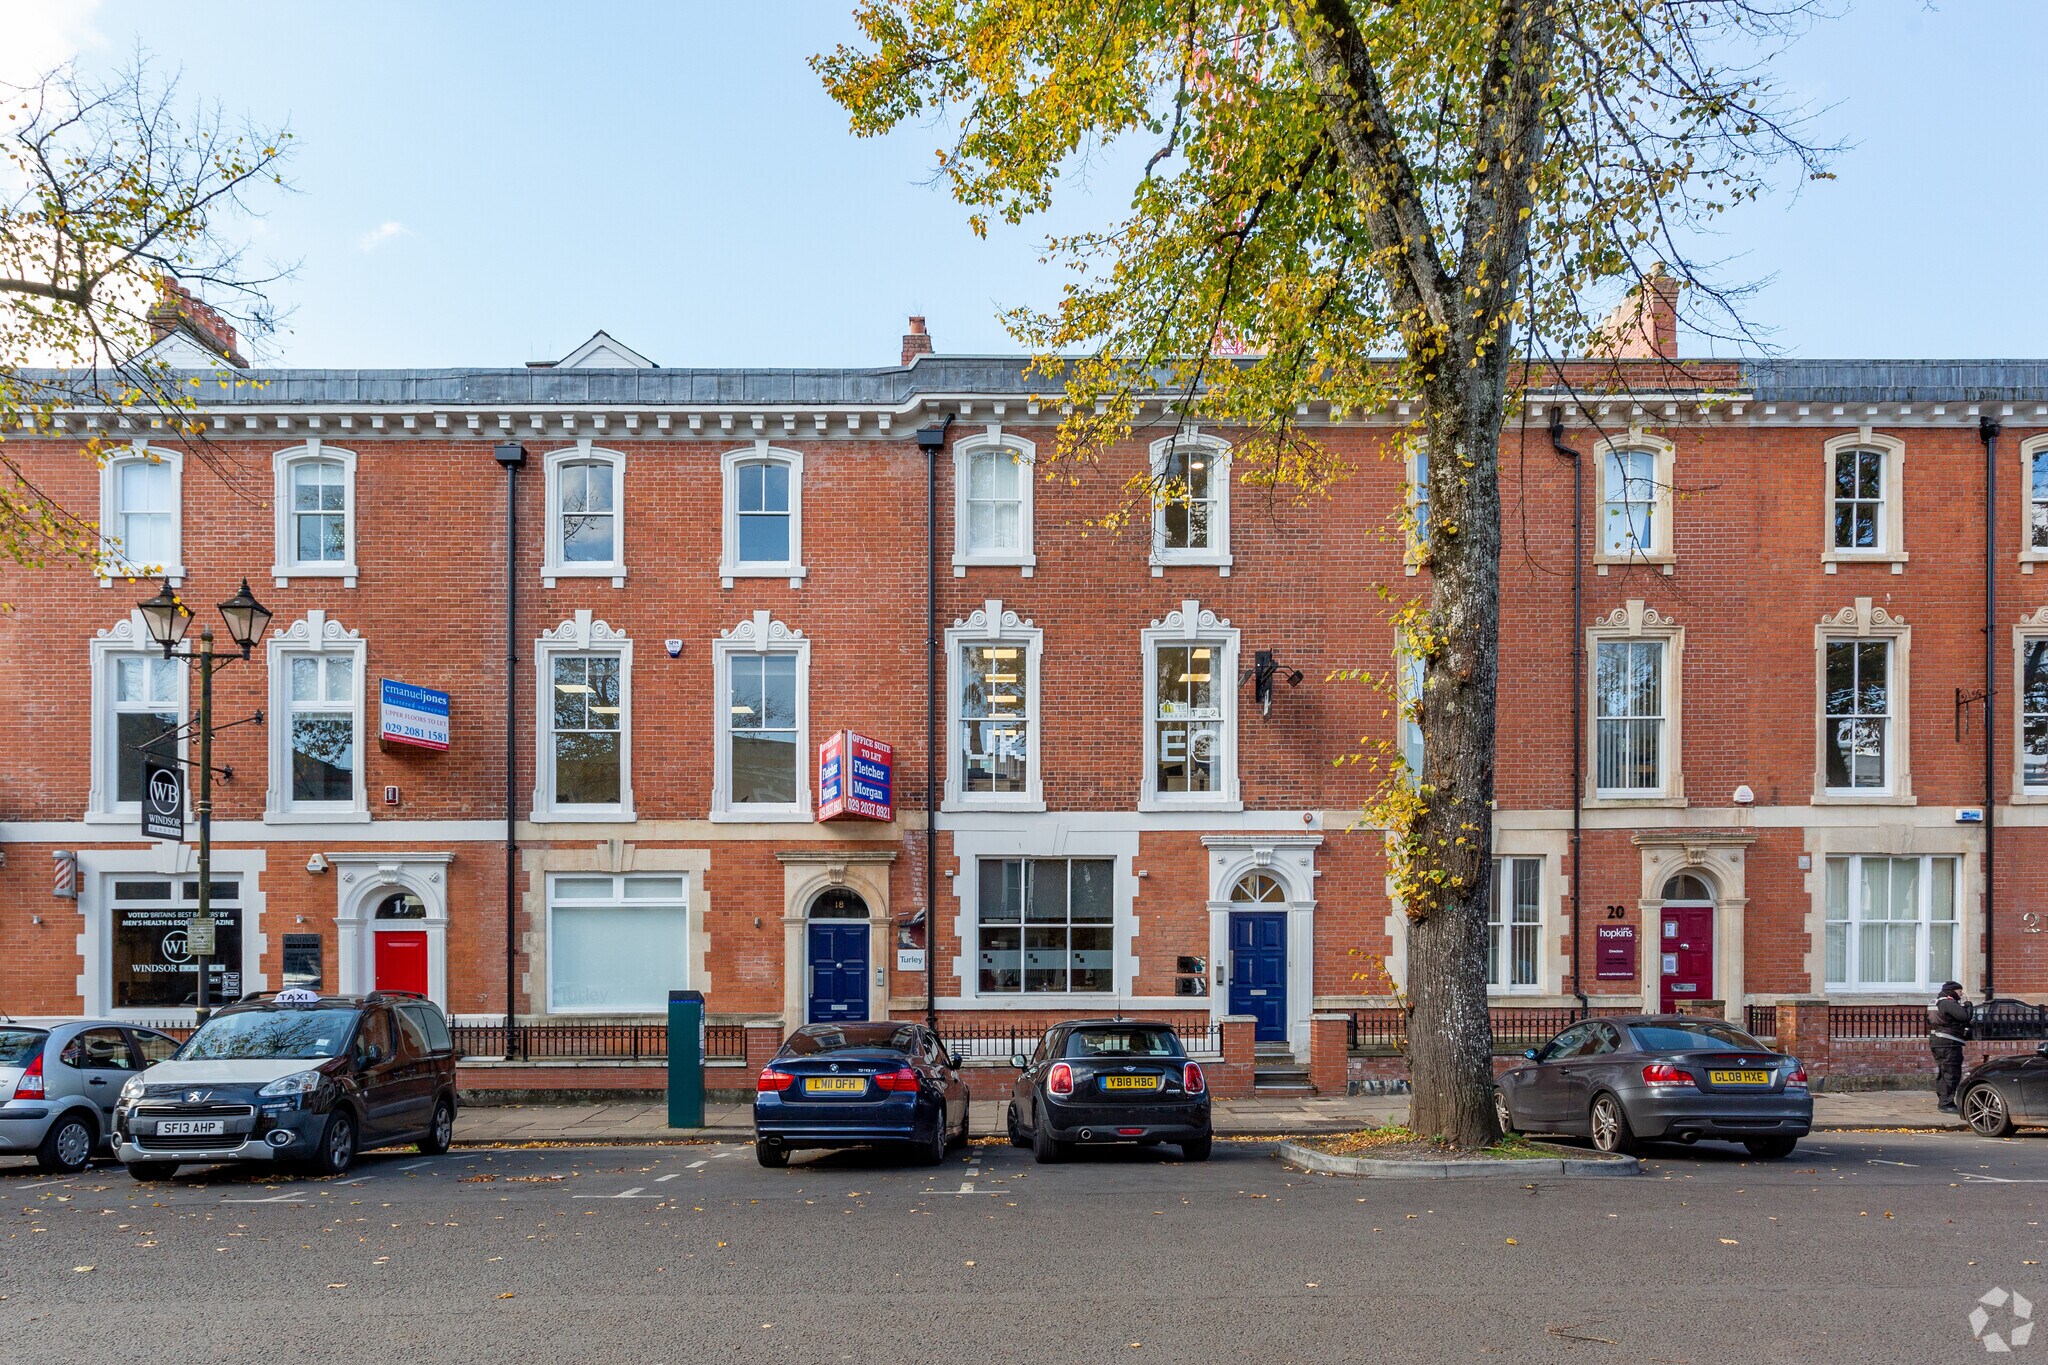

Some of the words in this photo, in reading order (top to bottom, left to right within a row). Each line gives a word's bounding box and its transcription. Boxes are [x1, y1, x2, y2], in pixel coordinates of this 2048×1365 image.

[384, 697, 415, 708] chartered
[418, 706, 446, 715] surveyors
[386, 710, 404, 718] UPPER
[404, 713, 426, 723] FLOORS
[386, 722, 402, 733] 029
[404, 726, 424, 738] 2081
[428, 730, 447, 742] 1581
[852, 734, 873, 748] OFFICE
[874, 741, 890, 753] SUITE
[862, 749, 870, 759] TO
[870, 752, 882, 762] LET
[822, 764, 838, 780] Fletcher
[854, 760, 884, 780] Fletcher
[152, 781, 178, 803] WB
[822, 786, 837, 800] Morgan
[854, 781, 883, 800] Morgan
[848, 798, 859, 812] 029
[860, 801, 875, 816] 2037
[876, 806, 890, 819] 8921
[149, 813, 181, 827] WINDSOR
[394, 900, 410, 913] 17
[1607, 906, 1624, 918] 20
[1600, 928, 1632, 938] hopkins
[900, 956, 922, 964] Turley
[132, 964, 177, 972] WINDSOR
[1110, 1078, 1132, 1086] YB18
[1134, 1078, 1153, 1086] HBG
[1715, 1072, 1742, 1082] GL08
[1745, 1072, 1763, 1081] HXE
[815, 1080, 832, 1088] LM11
[836, 1080, 855, 1088] OFH
[164, 1123, 190, 1133] SF13
[193, 1122, 215, 1132] AHP
